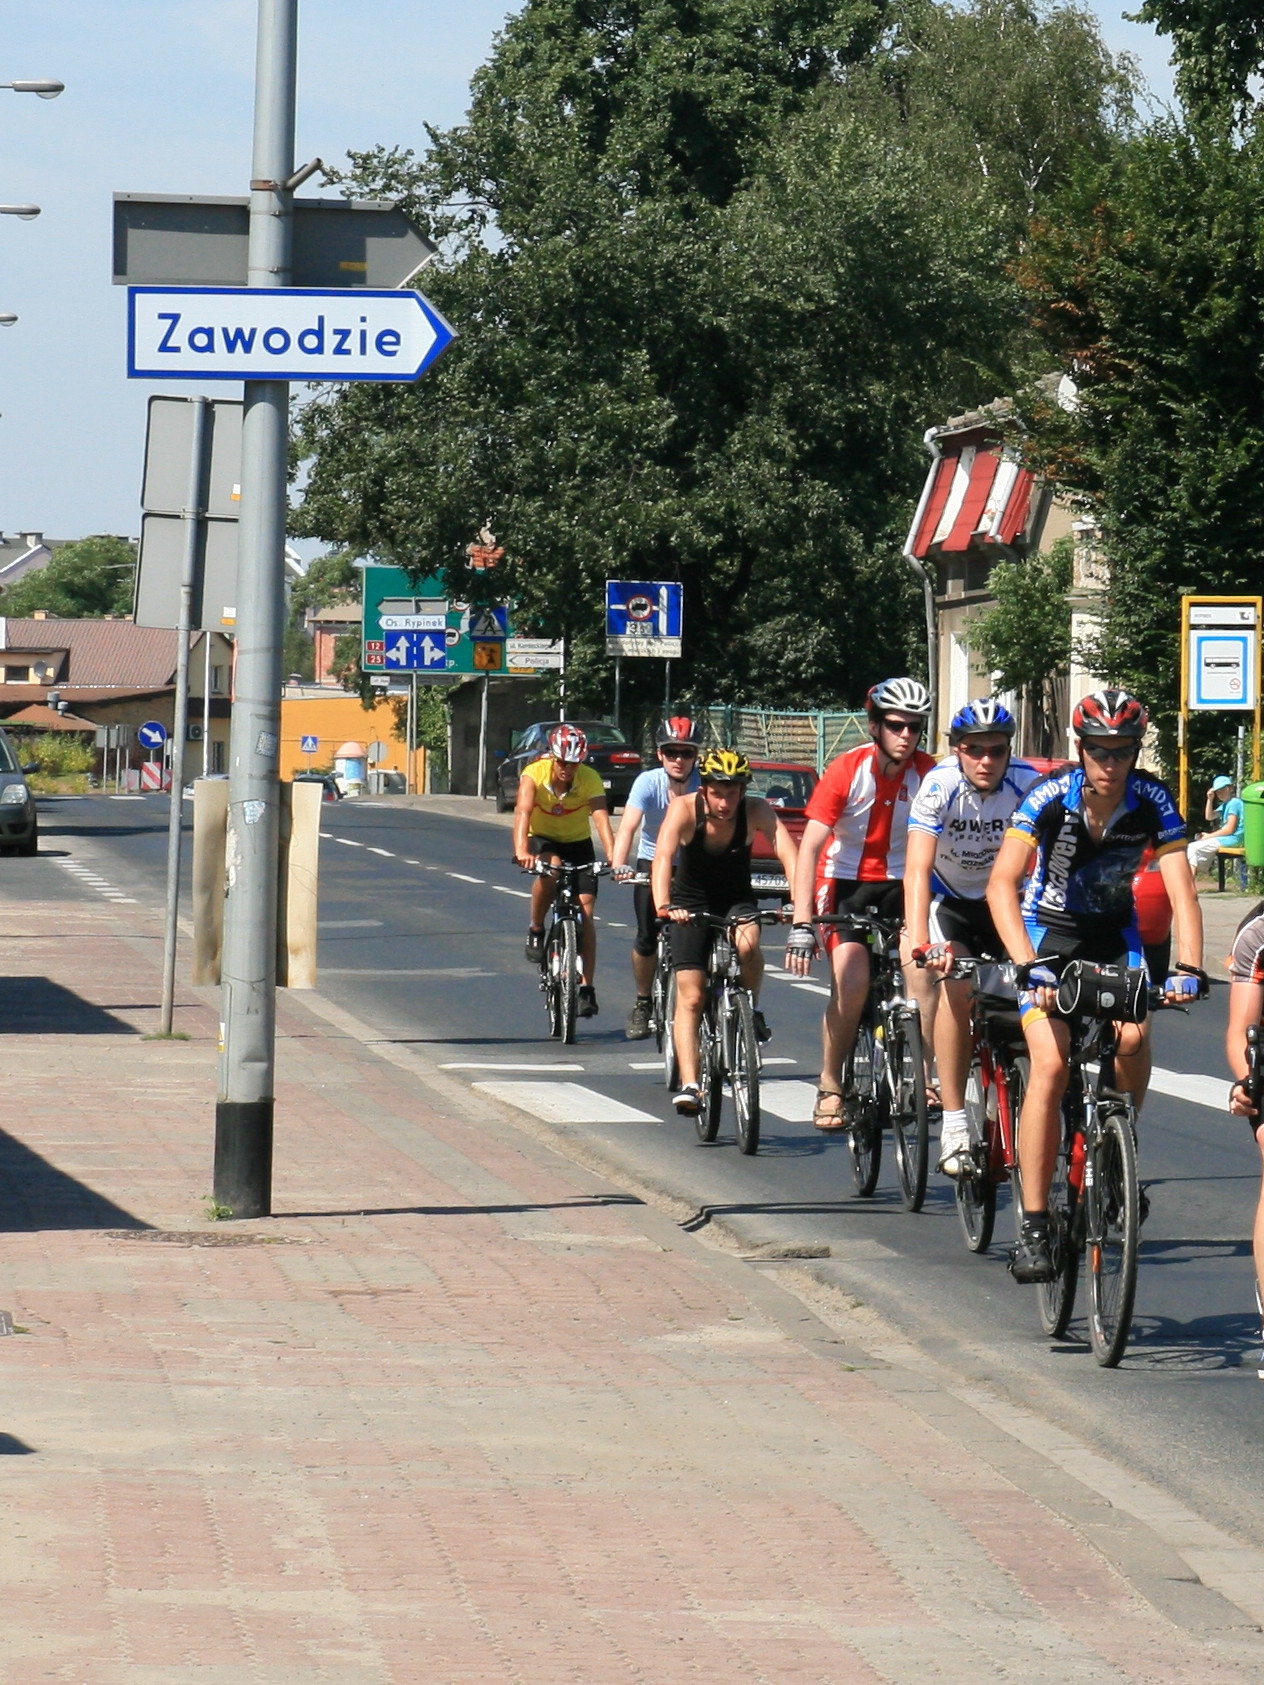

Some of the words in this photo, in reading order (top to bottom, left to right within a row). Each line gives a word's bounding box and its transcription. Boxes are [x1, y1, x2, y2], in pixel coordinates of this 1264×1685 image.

[156, 311, 402, 357] Zawodzie
[385, 618, 401, 627] Os.
[404, 618, 443, 628] Rypinek
[370, 642, 381, 650] 12
[370, 655, 382, 664] 25
[1028, 780, 1061, 811] AMD
[1132, 780, 1166, 804] AMD
